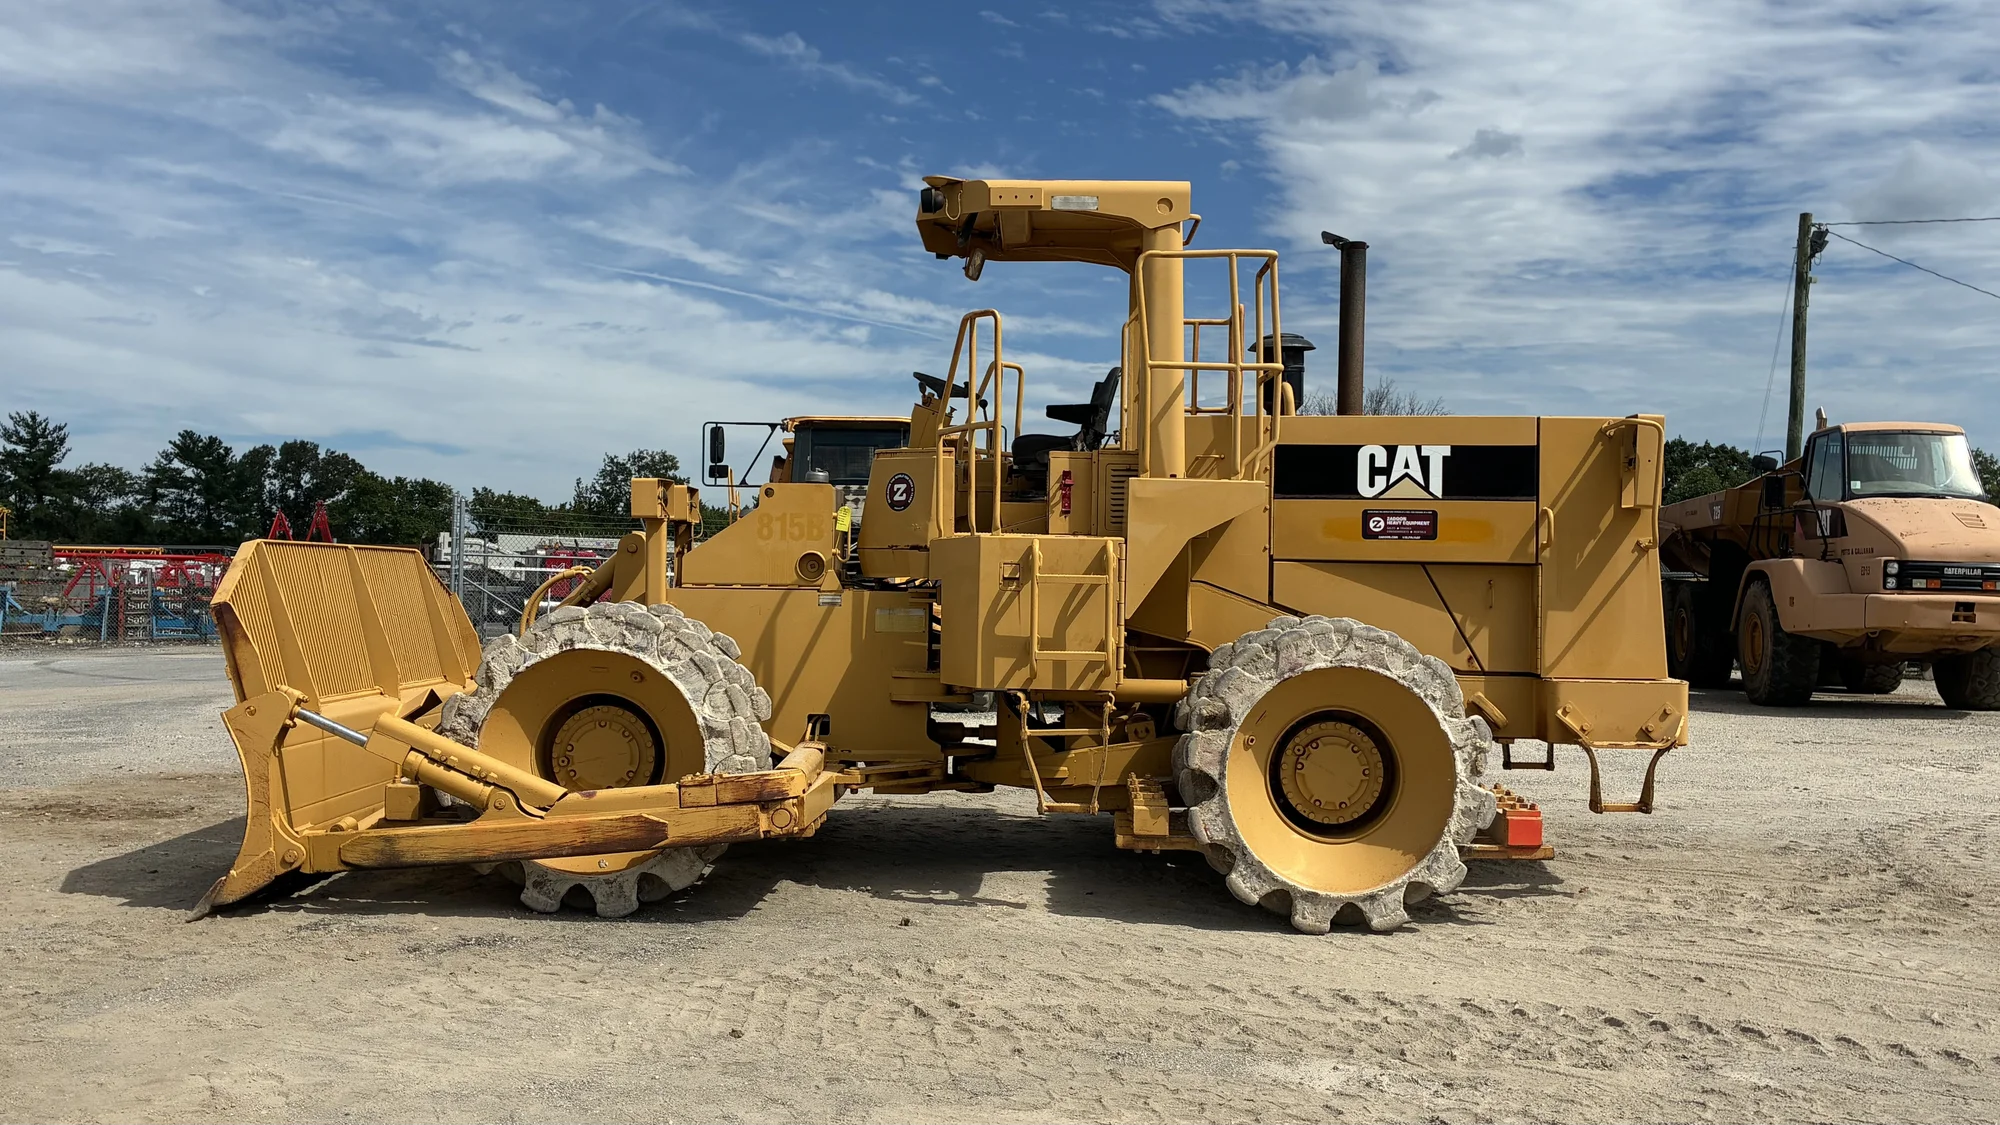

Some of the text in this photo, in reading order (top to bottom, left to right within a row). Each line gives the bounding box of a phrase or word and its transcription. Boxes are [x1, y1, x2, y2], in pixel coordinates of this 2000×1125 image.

[1357, 445, 1451, 499] CAT
[893, 483, 907, 501] Z
[757, 512, 826, 542] 815B
[1372, 520, 1382, 529] Z
[1943, 566, 1982, 576] CATERPILLAR
